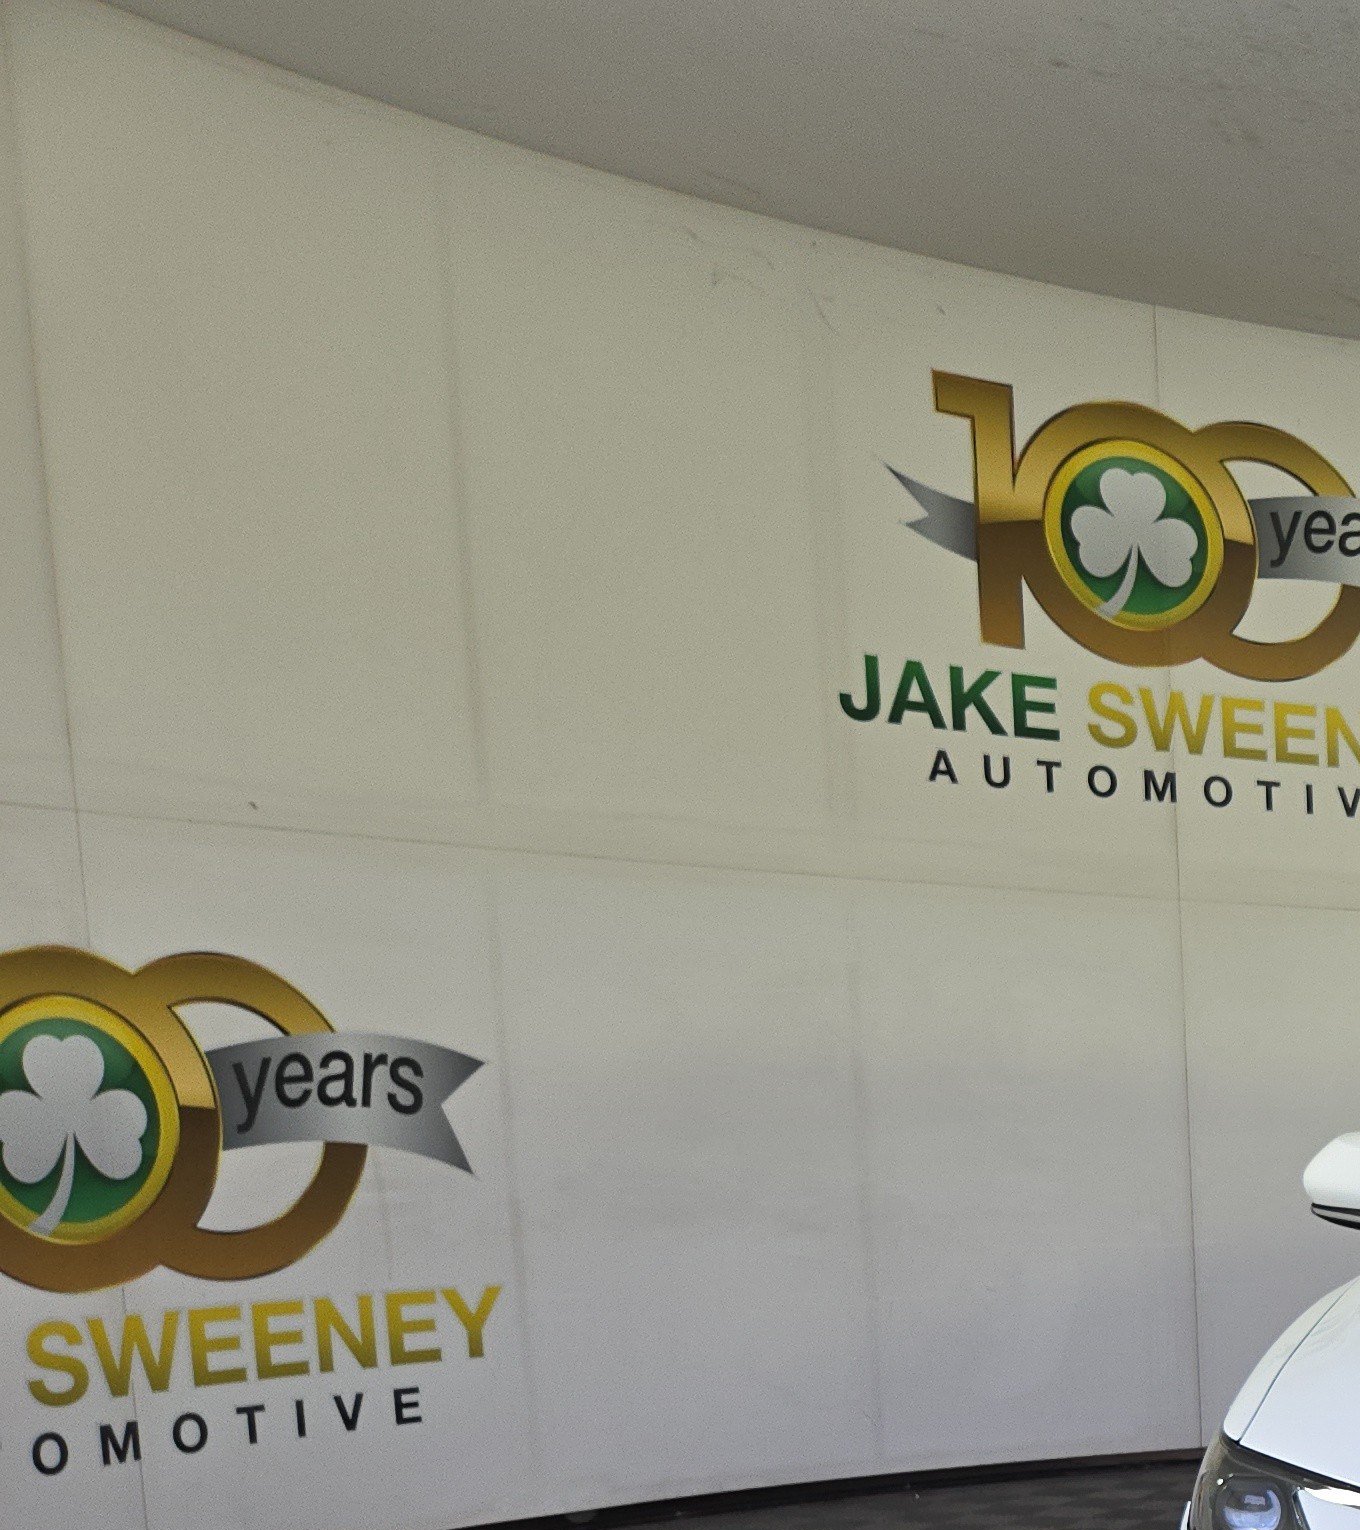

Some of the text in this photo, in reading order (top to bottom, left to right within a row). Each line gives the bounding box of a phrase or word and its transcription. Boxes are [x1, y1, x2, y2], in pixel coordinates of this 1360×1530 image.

[838, 654, 1060, 741] JAKE
[232, 1049, 424, 1134] years
[26, 1285, 502, 1407] SWEENEY
